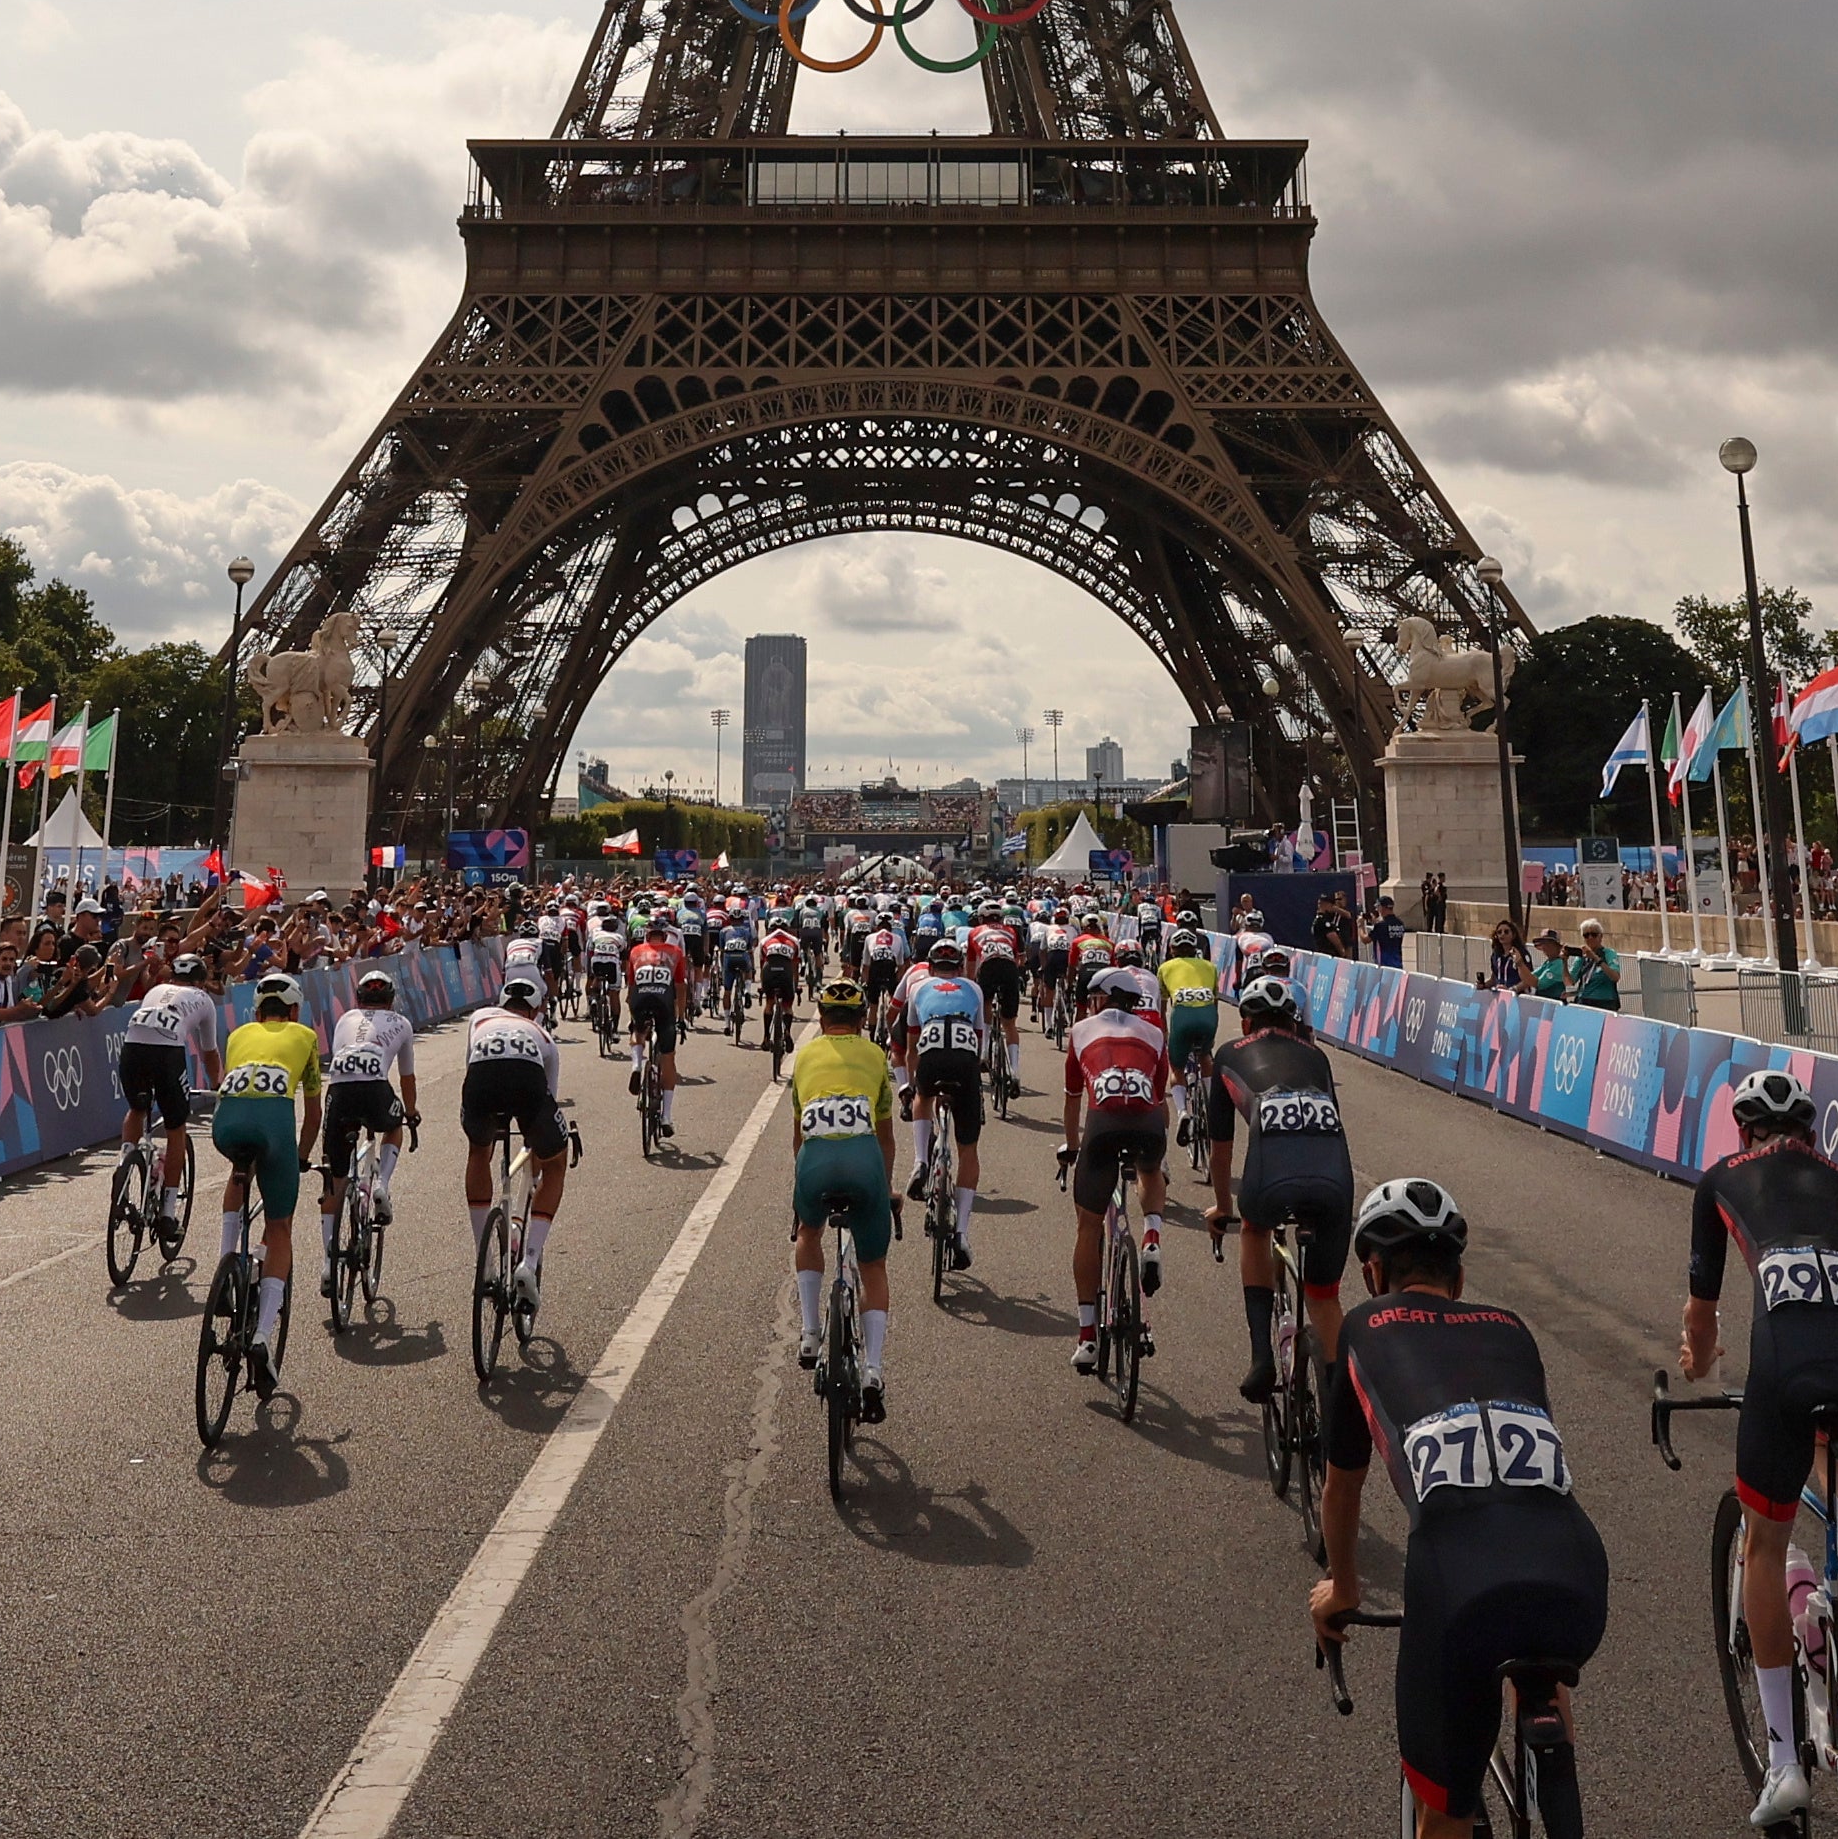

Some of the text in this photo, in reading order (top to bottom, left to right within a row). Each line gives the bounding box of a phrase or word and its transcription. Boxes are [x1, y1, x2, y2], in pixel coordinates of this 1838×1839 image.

[491, 873, 518, 882] 150m
[1176, 990, 1194, 1003] 35
[157, 1012, 179, 1031] 47
[475, 1038, 539, 1057] 43 43
[221, 1071, 287, 1095] 36 36
[1602, 1081, 1635, 1119] 2024
[802, 1103, 872, 1131] 34 34
[1262, 1102, 1341, 1129] 28 28
[1763, 1263, 1821, 1301] 29
[1368, 1307, 1438, 1328] GREAT
[1412, 1423, 1565, 1493] 27 27
